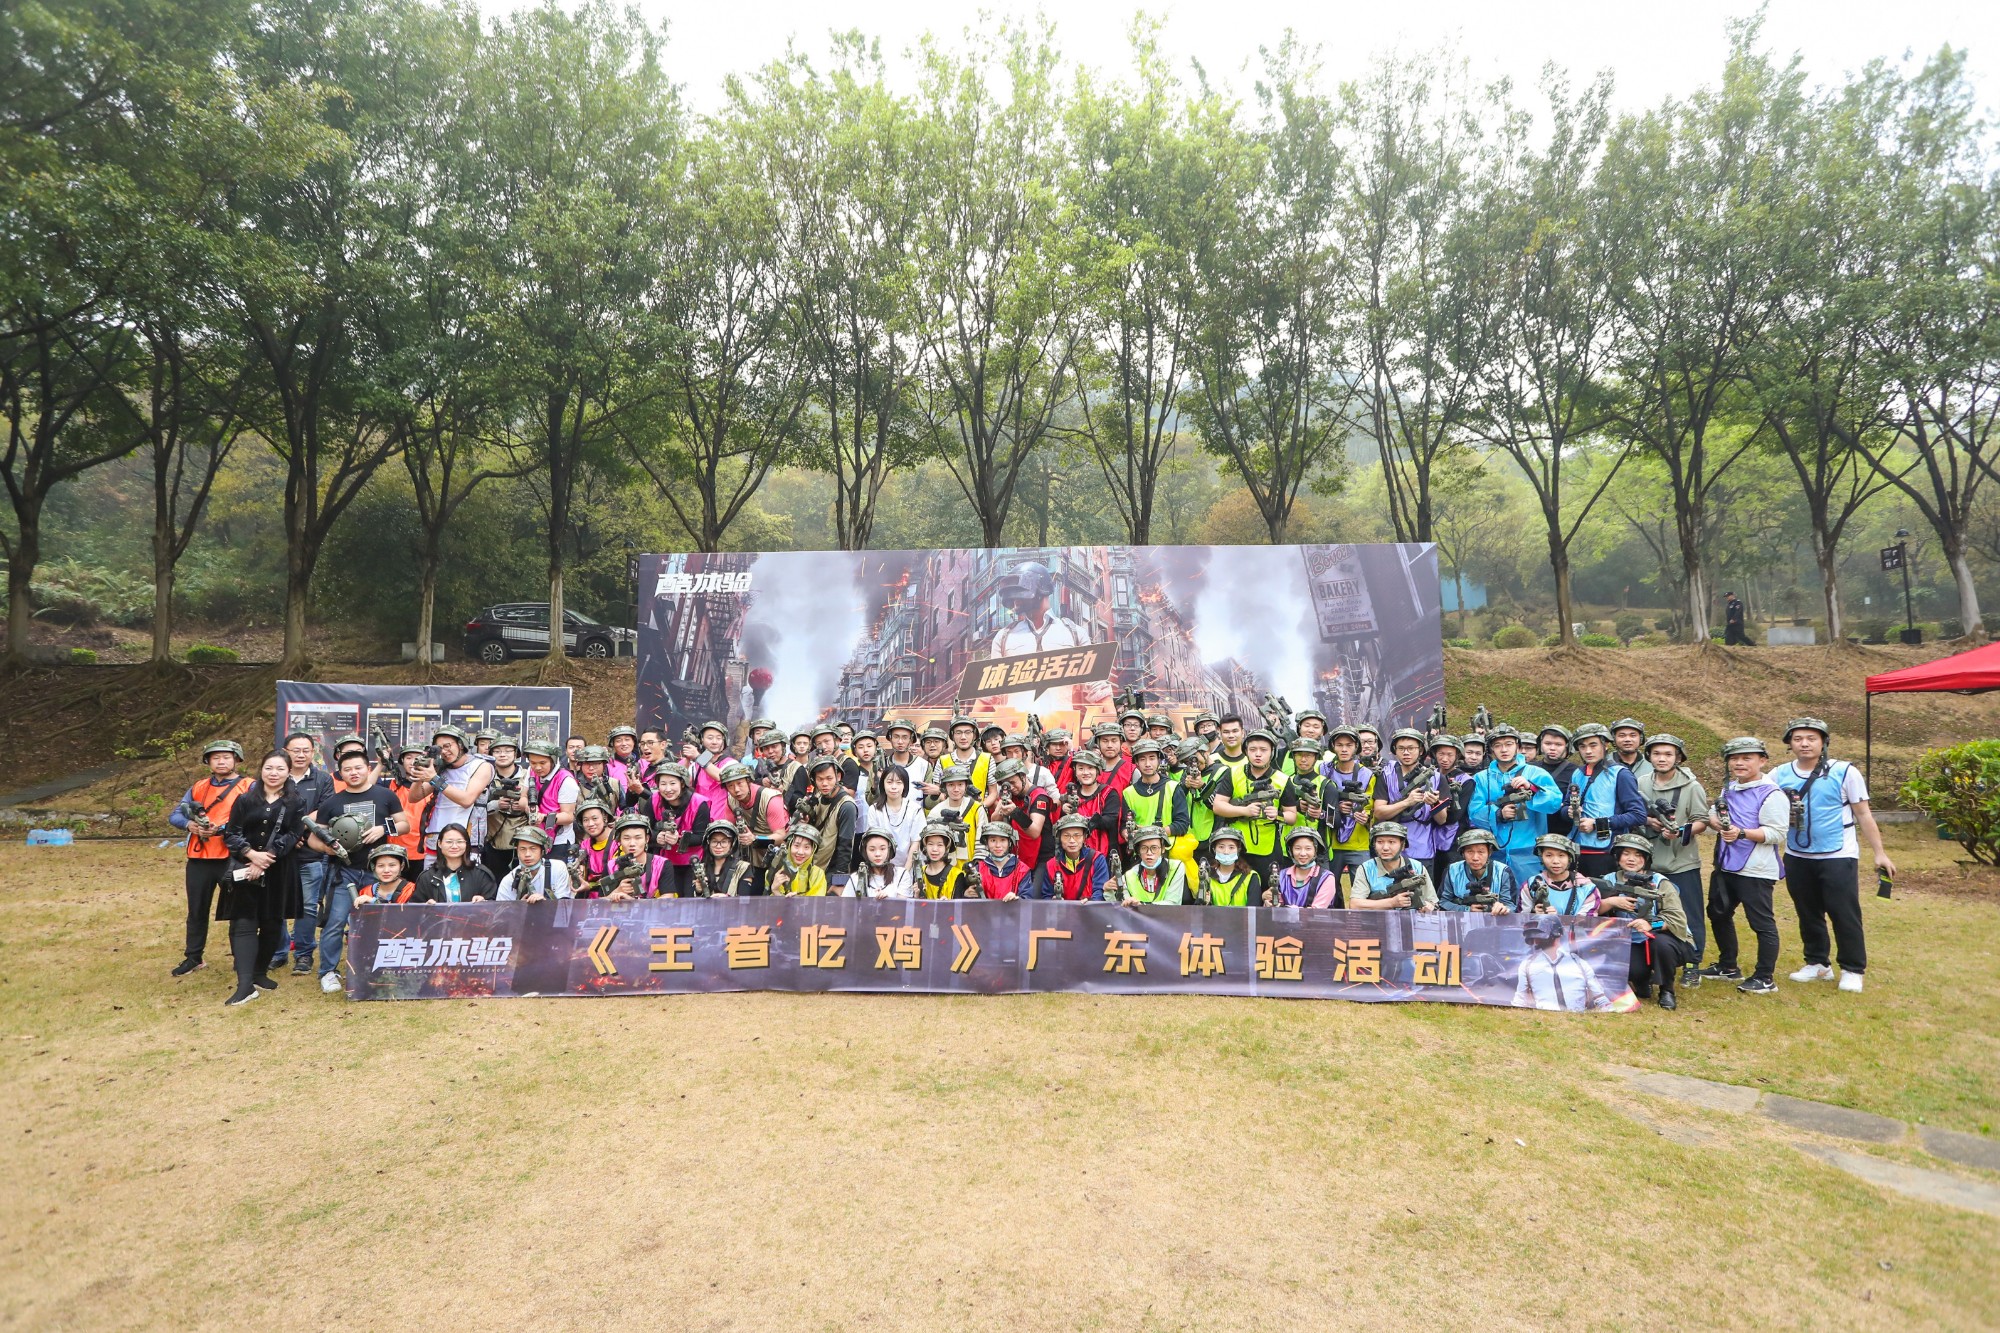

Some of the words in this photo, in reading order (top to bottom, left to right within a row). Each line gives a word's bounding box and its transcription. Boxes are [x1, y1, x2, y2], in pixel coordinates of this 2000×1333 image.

[654, 572, 753, 597] 酷体验
[1318, 580, 1360, 598] BAKERY
[977, 650, 1097, 690] 体验活动
[372, 937, 513, 972] 酷体验
